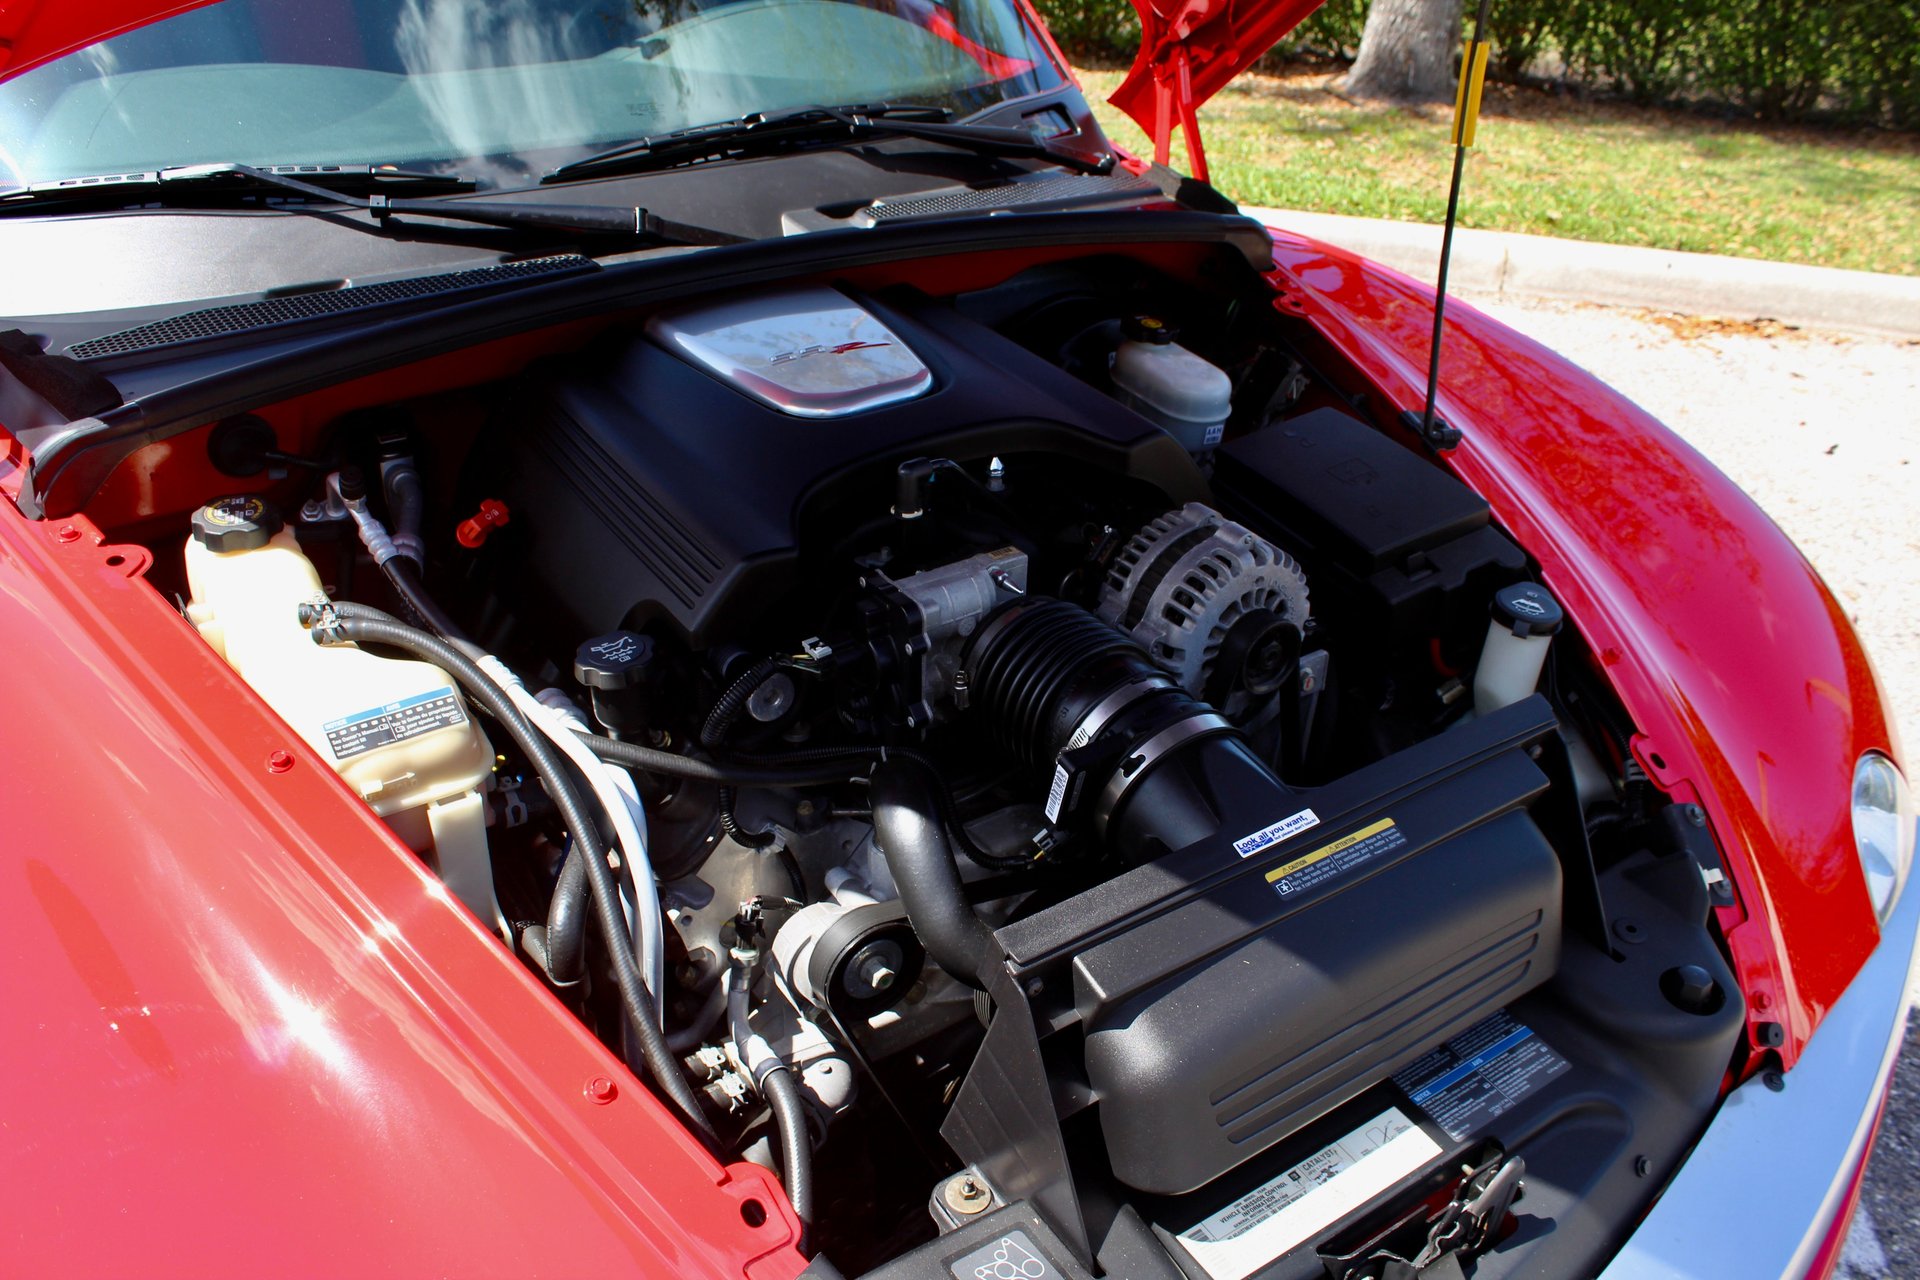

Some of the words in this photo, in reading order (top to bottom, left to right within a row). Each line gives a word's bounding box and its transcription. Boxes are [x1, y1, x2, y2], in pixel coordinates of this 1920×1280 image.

[1236, 838, 1258, 850] Look
[1258, 832, 1269, 840] all
[1269, 826, 1284, 836] you
[1285, 815, 1308, 827] want,
[1335, 837, 1356, 849] ATTENTION
[1288, 860, 1307, 870] CAUTION
[1220, 1209, 1241, 1223] VEHICLE
[1241, 1195, 1265, 1210] EMISSION
[1265, 1182, 1287, 1196] CONTROL
[1242, 1196, 1275, 1216] INFORMATION
